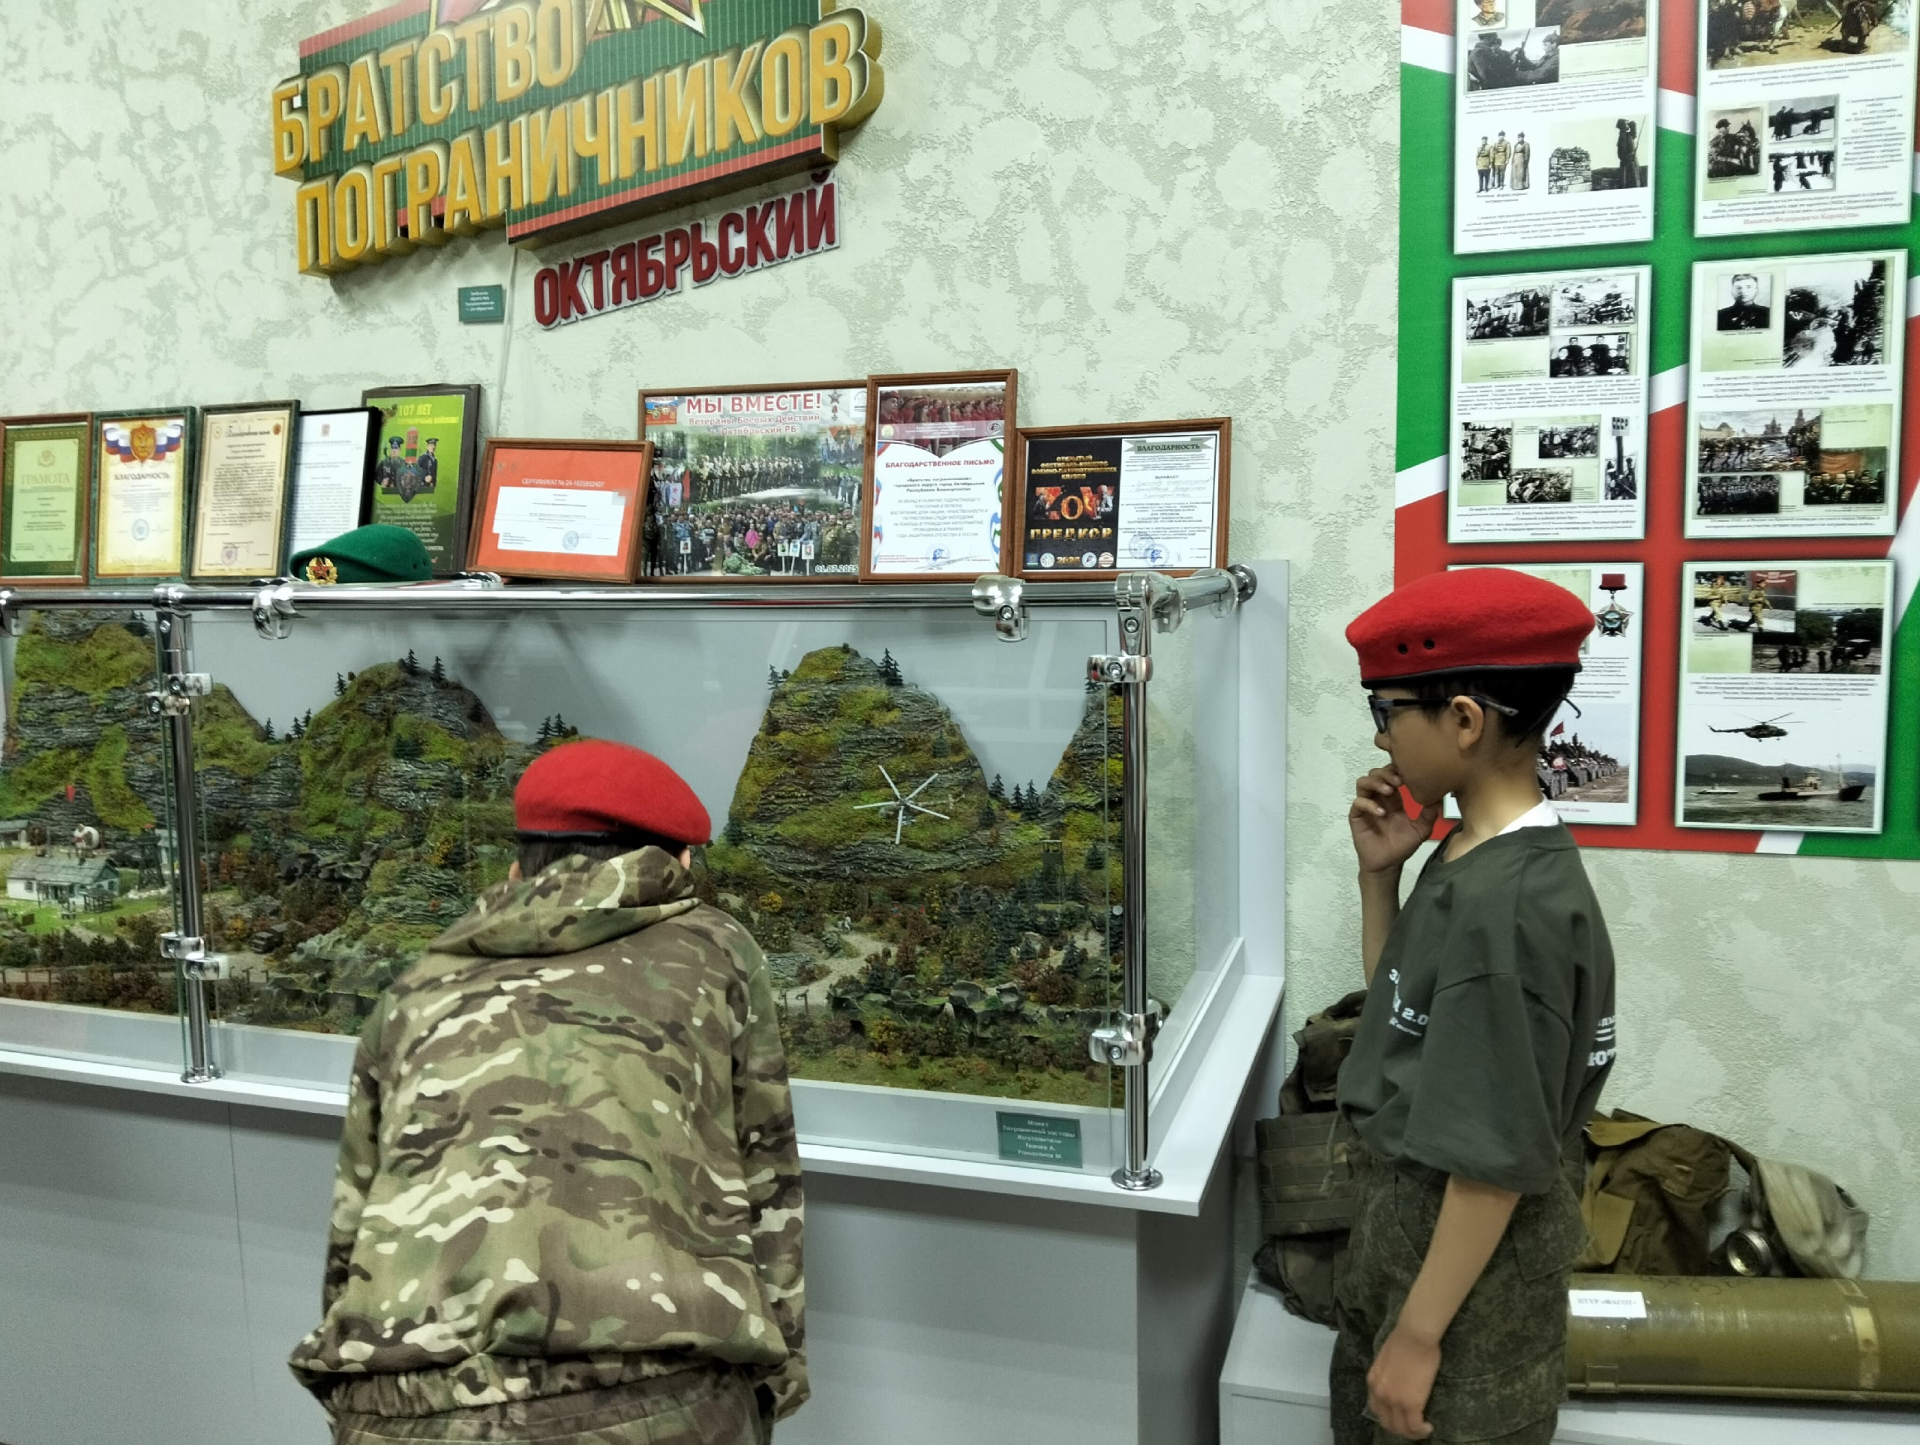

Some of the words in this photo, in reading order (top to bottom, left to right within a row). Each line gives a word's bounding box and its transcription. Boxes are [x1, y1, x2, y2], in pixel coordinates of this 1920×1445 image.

[272, 0, 578, 176] БРАТСТВО
[296, 20, 862, 274] ПОГРАНИЧНИКОВ
[534, 174, 837, 326] ОКТЯБРЬСКИЙ
[686, 397, 722, 414] МЫ
[731, 393, 821, 413] ВМЕСТЕ!
[399, 405, 415, 416] 107
[689, 417, 734, 427] Ветераны
[775, 413, 820, 425] Действий
[720, 425, 782, 436] Октябрьский
[785, 425, 797, 433] РБ
[1137, 443, 1200, 452] БЛАГОДАРНОСТЬ
[885, 460, 962, 468] БЛАГОДАРСТВЕННОЕ
[20, 472, 71, 485] ГРАМОТА
[114, 472, 171, 480] БЛАГОДАРНОСТЬ
[1030, 528, 1113, 540] ПРЕДКОВ
[1402, 1007, 1429, 1025] 2.0
